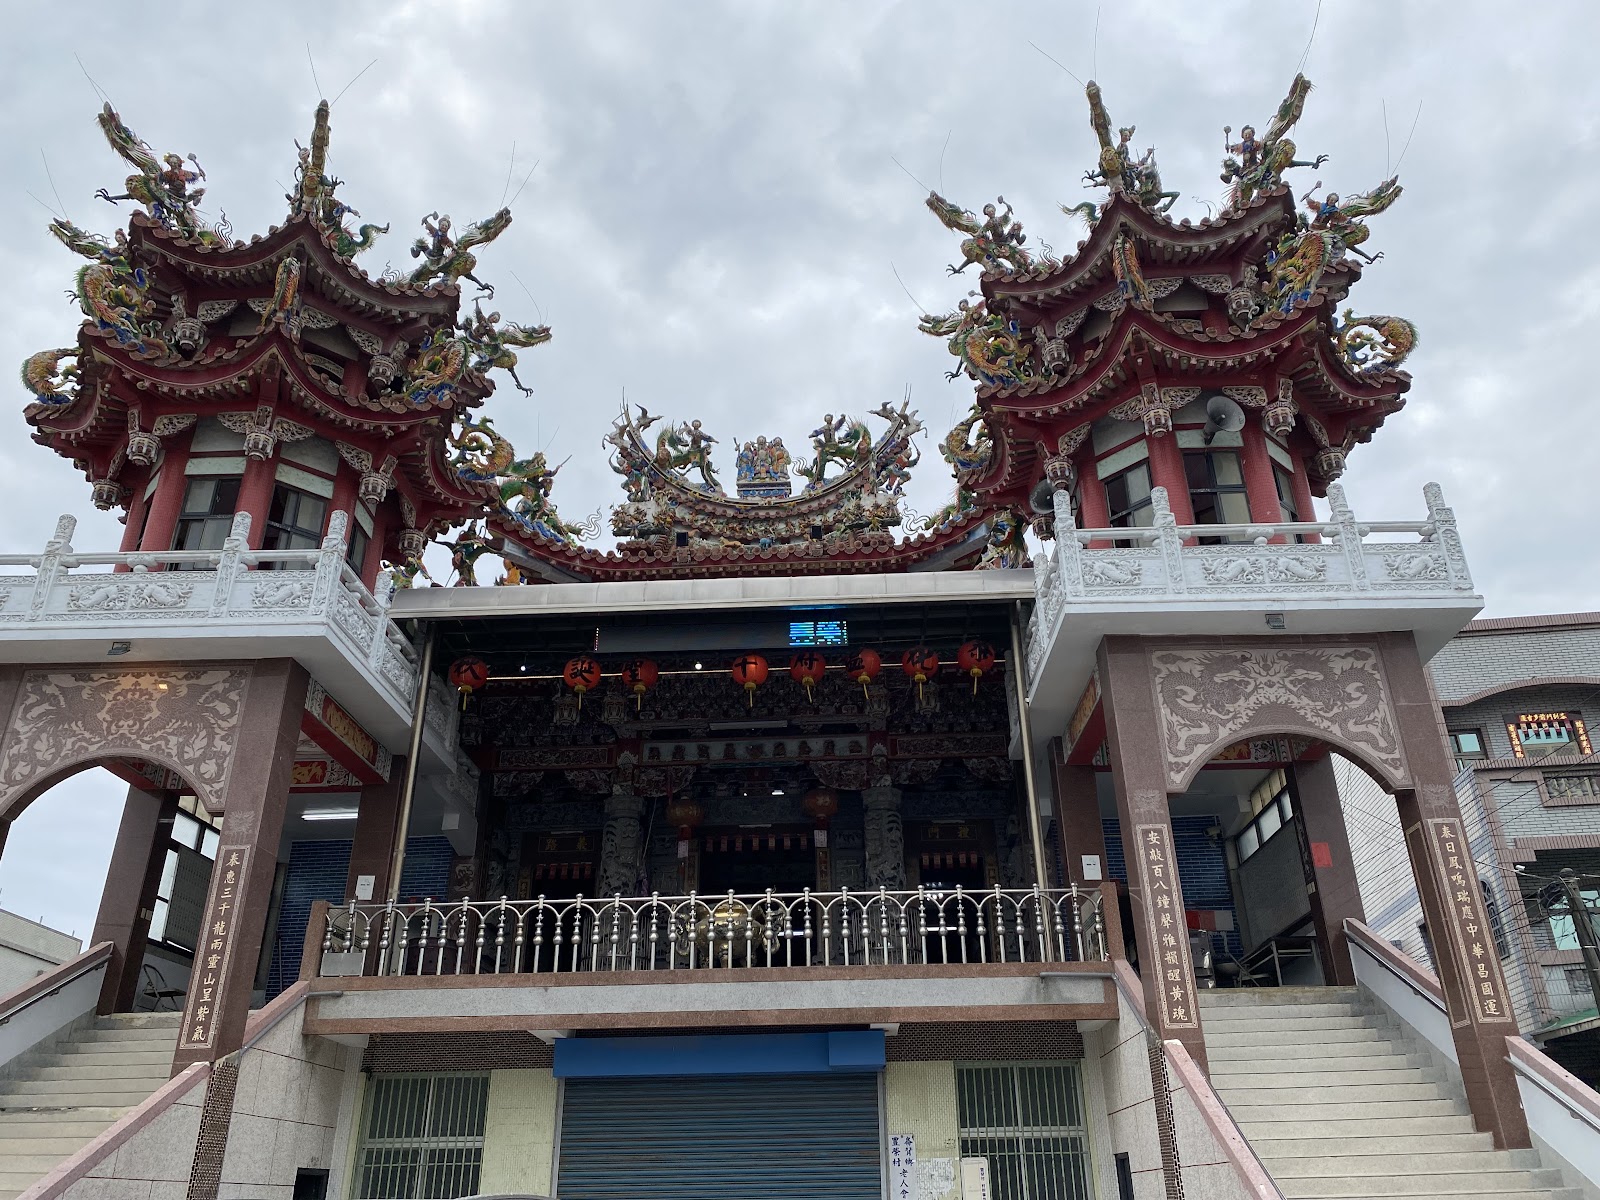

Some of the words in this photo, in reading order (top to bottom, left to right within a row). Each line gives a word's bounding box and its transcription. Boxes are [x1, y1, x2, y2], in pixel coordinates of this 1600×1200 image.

[570, 657, 594, 683] 誕
[899, 1168, 909, 1199] 老人會
